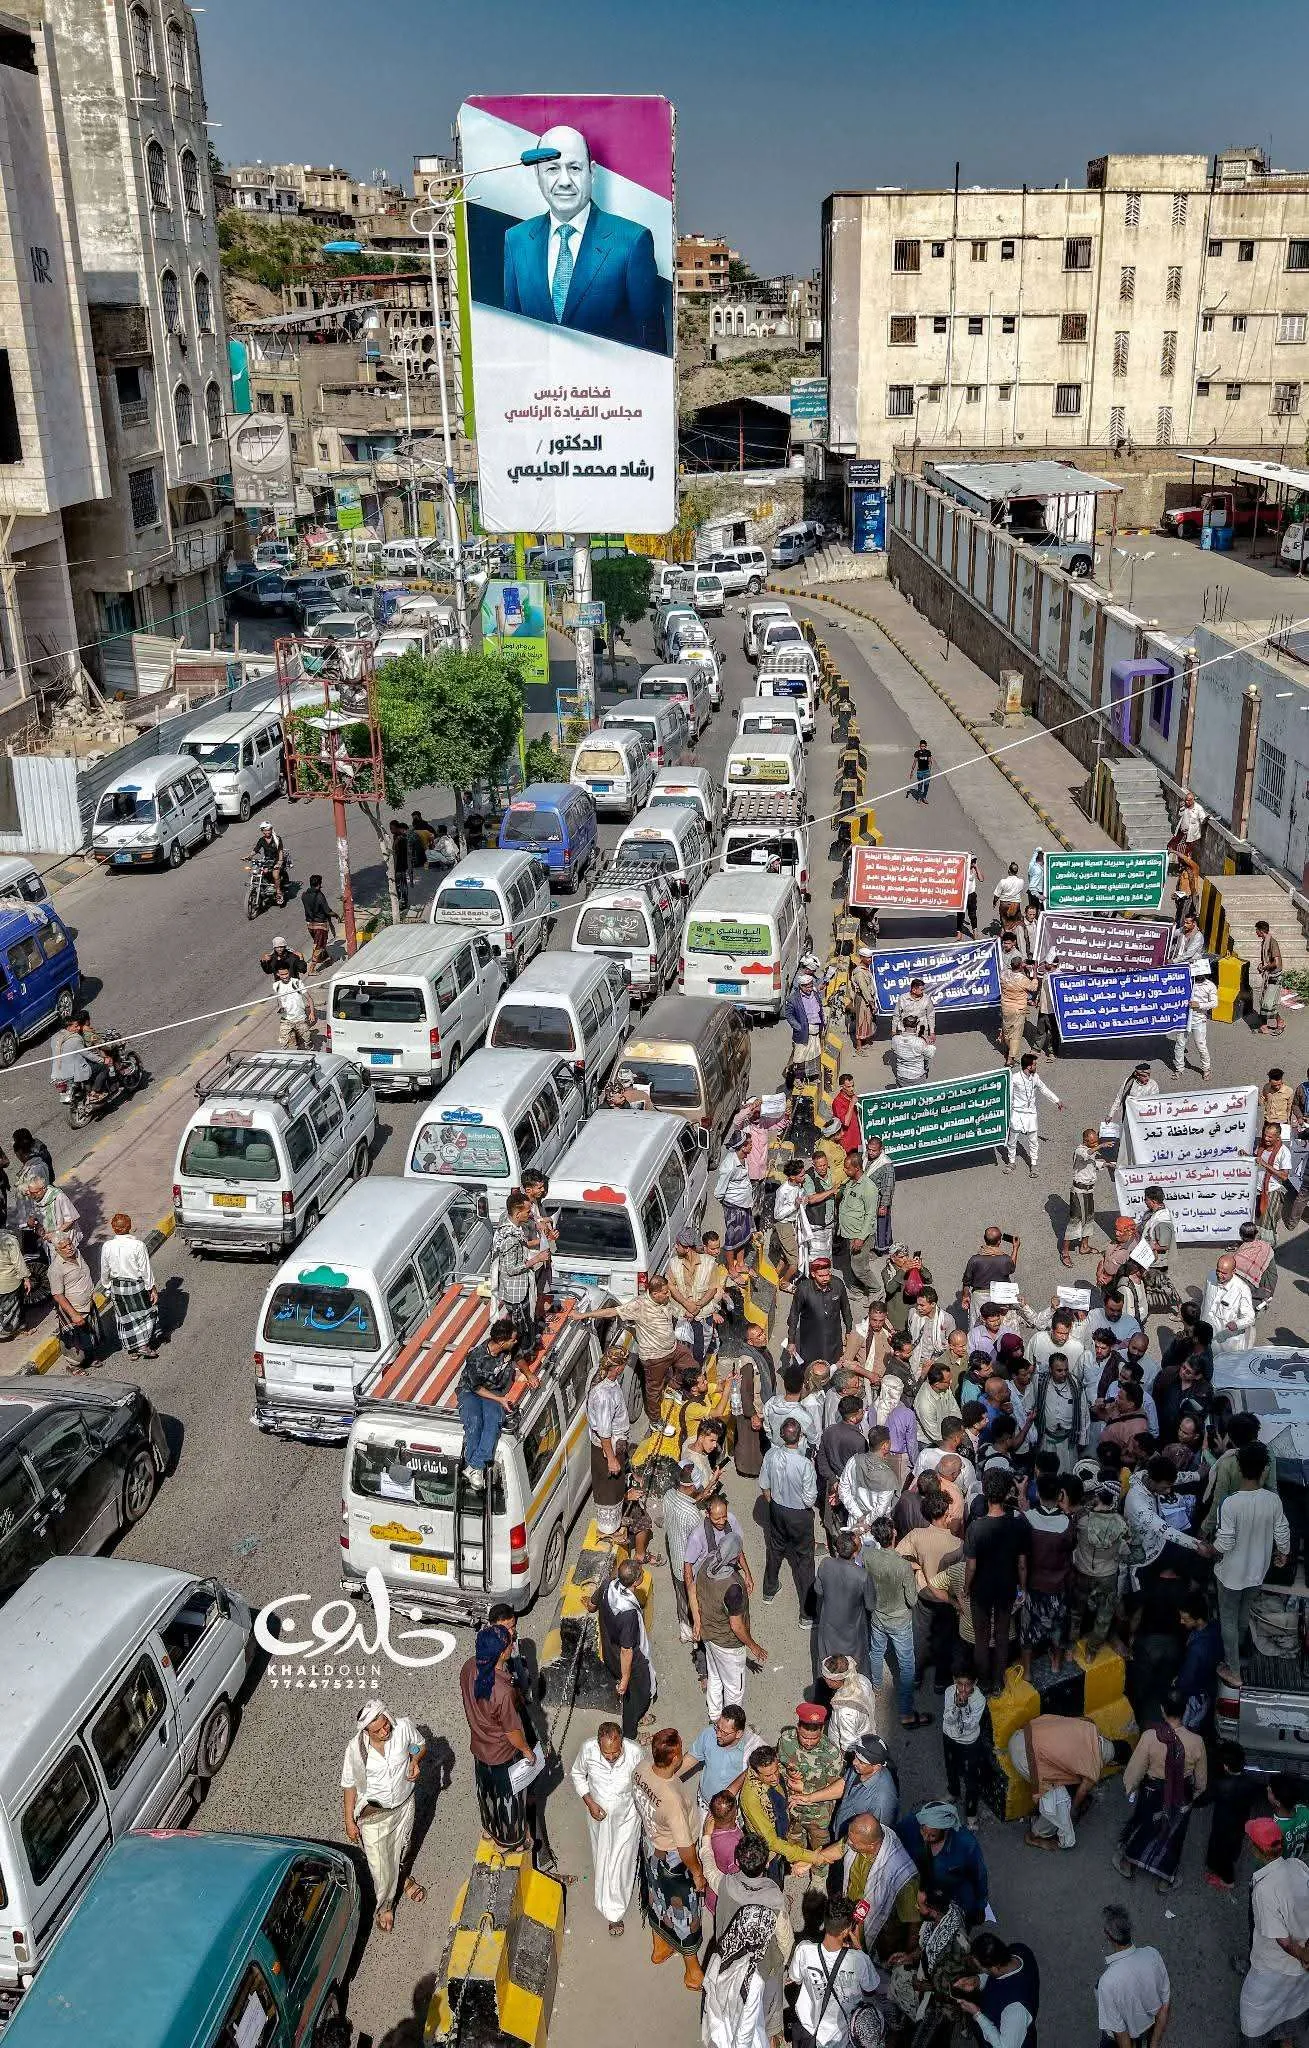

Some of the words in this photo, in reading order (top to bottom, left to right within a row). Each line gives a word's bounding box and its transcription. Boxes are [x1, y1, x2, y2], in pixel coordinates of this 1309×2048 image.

[534, 386, 568, 401] رئيس
[570, 386, 611, 399] فخامة
[504, 406, 551, 422] الرئاسي
[554, 406, 598, 420] القيادة
[600, 406, 642, 421] مجلس
[549, 434, 602, 455] الدكتور
[507, 462, 569, 484] العليمي
[572, 462, 617, 477] محمد
[620, 459, 655, 481] رشاد
[1052, 922, 1077, 930] محافظ
[1107, 927, 1134, 937] الباصات
[1056, 936, 1087, 945] شمسان
[1136, 929, 1160, 940] سائقي
[1089, 939, 1106, 948] نبيل
[1107, 941, 1123, 949] تعز
[1125, 942, 1154, 951] محافظة
[930, 953, 955, 967] عشرة
[956, 954, 970, 963] من
[1068, 949, 1101, 960] المحافظة
[1103, 953, 1122, 961] حصة
[1124, 955, 1152, 965] بمتابعة
[877, 960, 890, 975] في
[892, 959, 910, 971] باص
[913, 957, 927, 967] الف
[883, 978, 896, 989] من
[923, 972, 954, 985] المدينة
[1088, 978, 1117, 987] مديريات
[1120, 975, 1131, 987] في
[1133, 974, 1159, 984] الباصات
[1162, 973, 1185, 985] سائقي
[1060, 980, 1085, 990] المدينة
[931, 992, 943, 1004] في
[946, 987, 969, 998] خانقة
[1064, 993, 1088, 1003] القيادة
[1090, 992, 1116, 1002] مجلس
[1119, 990, 1145, 1000] رئيس
[1148, 986, 1185, 998] يناشدون
[1098, 1006, 1119, 1015] صرف
[1121, 1003, 1157, 1013] الحكومة
[1160, 1000, 1188, 1011] ورئيس
[1064, 1008, 1096, 1018] حصتهم
[1173, 1013, 1186, 1022] من
[1067, 1019, 1097, 1031] الشركة
[1099, 1021, 1110, 1029] من
[1112, 1017, 1149, 1026] المعتمدة
[1151, 1015, 1170, 1025] الغاز
[978, 1081, 1001, 1092] وكلاء
[918, 1092, 945, 1106] تموين
[948, 1088, 976, 1098] محطات
[881, 1097, 916, 1110] السيارات
[941, 1102, 966, 1114] المدينة
[968, 1097, 1000, 1108] مديريات
[1167, 1099, 1199, 1116] عشرة
[1204, 1100, 1218, 1114] من
[1223, 1094, 1247, 1113] أكثر
[867, 1103, 879, 1116] في
[911, 1108, 939, 1120] يناشدن
[1139, 1102, 1162, 1116] ألف
[888, 1113, 909, 1125] المدير
[975, 1109, 1004, 1124] التنفيذي
[866, 1118, 886, 1129] العام
[916, 1123, 938, 1135] محسن
[940, 1116, 974, 1130] المهندس
[1225, 1120, 1245, 1133] باص
[954, 1130, 975, 1141] كاملة
[977, 1125, 1002, 1135] الحصة
[1144, 1126, 1162, 1141] تعز
[1168, 1125, 1204, 1136] محافظة
[1209, 1122, 1221, 1137] في
[884, 1141, 916, 1154] لمحافظة
[918, 1135, 952, 1148] المخصصة
[1151, 1150, 1173, 1162] الغاز
[1178, 1149, 1190, 1160] من
[1195, 1145, 1237, 1159] محرومون
[1149, 1170, 1181, 1184] اليمنية
[1186, 1166, 1219, 1181] الشركة
[1223, 1167, 1252, 1179] نطالب
[1123, 1173, 1143, 1186] للغاز
[1164, 1192, 1194, 1201] المحافظ
[1198, 1190, 1216, 1198] حصة
[1221, 1190, 1250, 1201] بترحيل
[1182, 1208, 1216, 1218] للسيارات
[1220, 1207, 1251, 1218] المخصص
[1183, 1224, 1208, 1233] الحصة
[274, 1297, 300, 1321] الله
[302, 1304, 368, 1332] ماشاء
[406, 1457, 422, 1470] الله
[423, 1458, 448, 1475] ماشاء
[421, 1562, 437, 1573] 118
